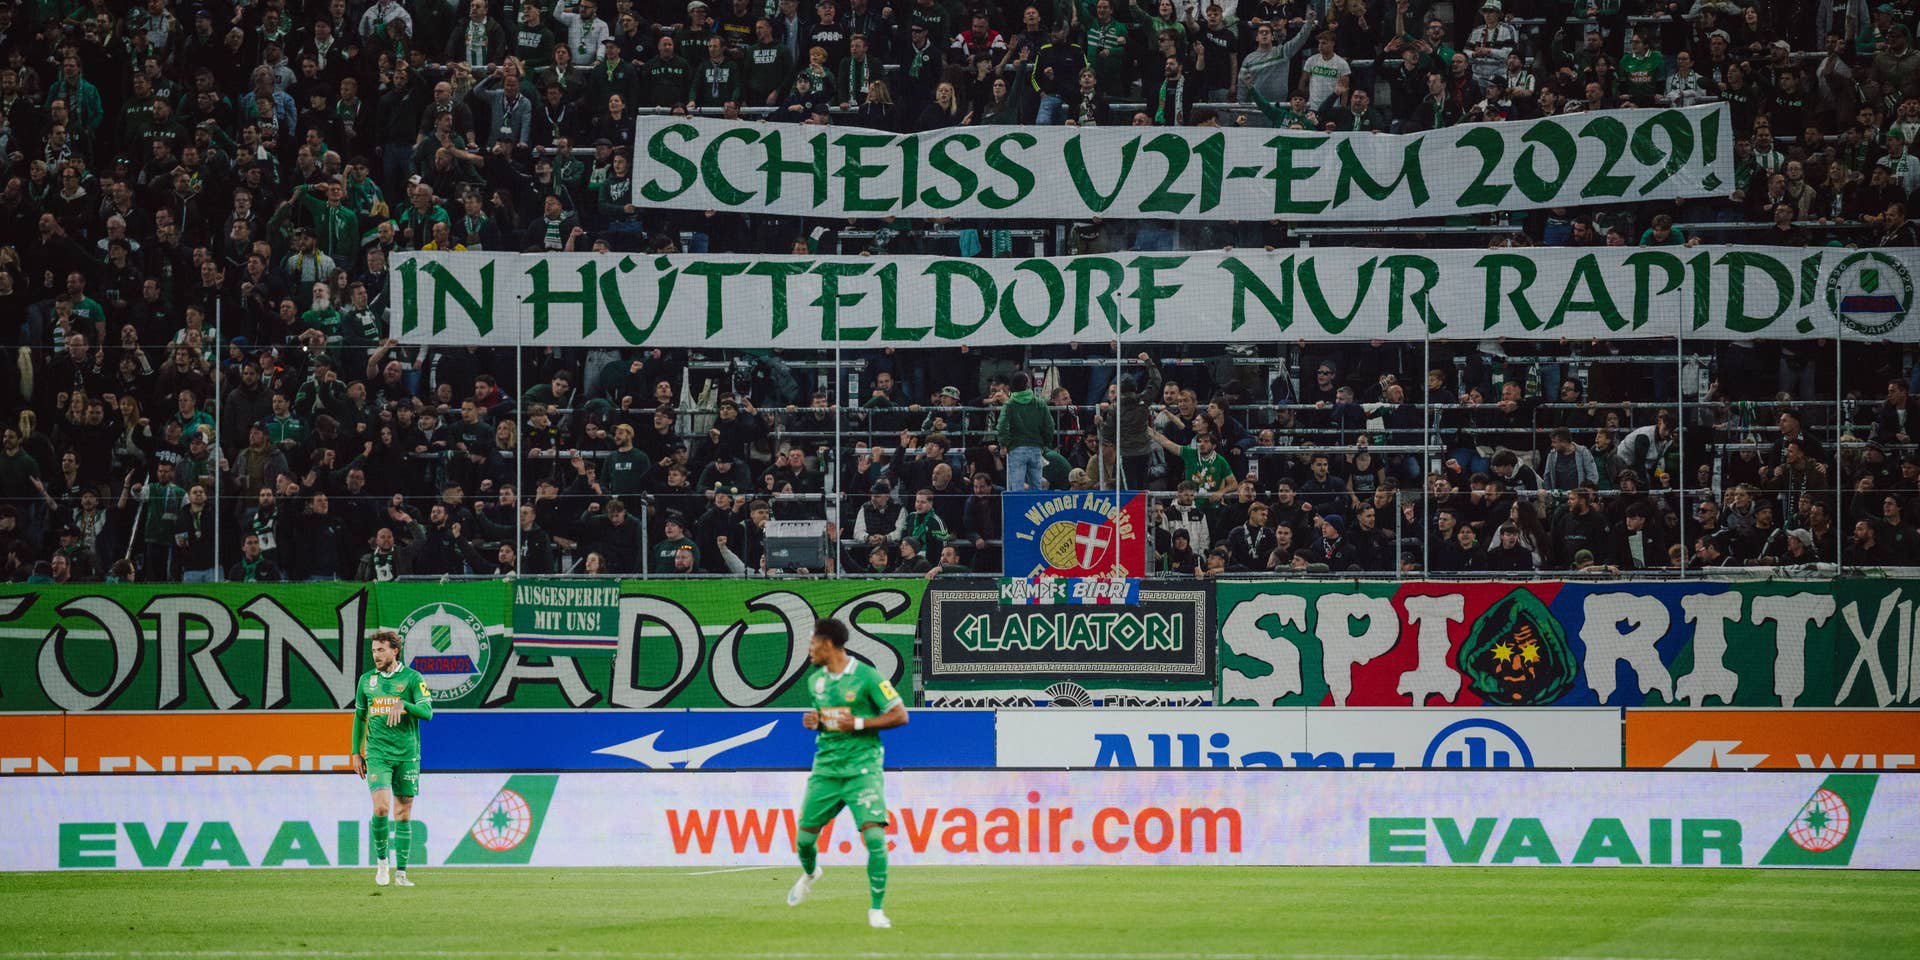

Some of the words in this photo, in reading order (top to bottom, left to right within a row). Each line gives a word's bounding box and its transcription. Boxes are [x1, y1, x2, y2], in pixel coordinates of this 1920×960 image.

[640, 123, 1037, 212] SCHEISS
[1062, 131, 1430, 214] U21-EM
[1455, 108, 1721, 208] 2029!
[395, 257, 495, 338] IN
[522, 254, 1189, 346] HÜTTELDORF
[1217, 254, 1447, 336] NUR
[1474, 250, 1823, 336] RAPID!
[1025, 494, 1079, 526] Wiener
[1083, 493, 1136, 540] Arbeiter
[1055, 537, 1073, 556] 1897
[515, 585, 620, 608] AUSGESPERRTE
[1072, 581, 1131, 599] BIRRI
[465, 615, 489, 651] 2026
[534, 611, 562, 630] MIT
[566, 612, 602, 632] UNS!
[953, 612, 1184, 651] GLADIATORI
[0, 591, 369, 711] ORN
[414, 656, 471, 673] TORNADOS
[431, 678, 475, 700] JAHRE
[375, 697, 399, 705] WIEN
